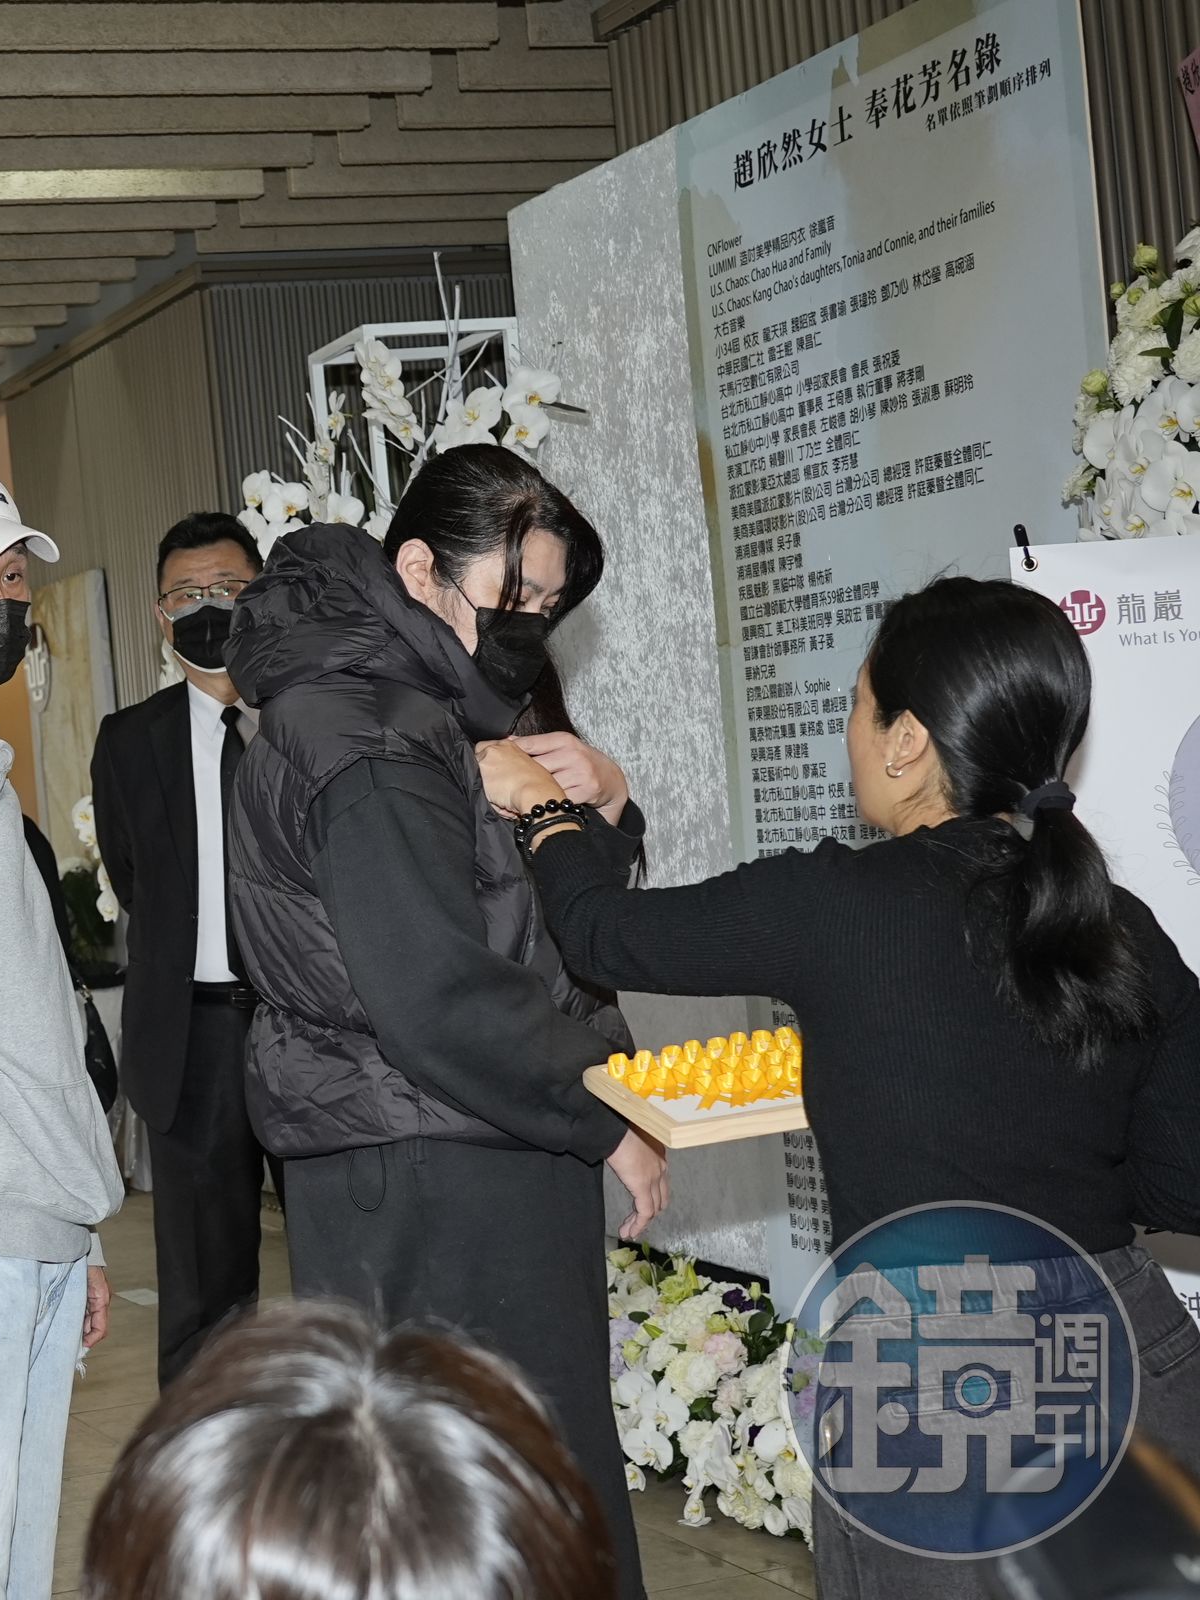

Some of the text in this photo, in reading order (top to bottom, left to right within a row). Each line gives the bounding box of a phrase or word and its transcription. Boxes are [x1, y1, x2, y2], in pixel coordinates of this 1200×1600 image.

[733, 31, 1002, 192] 趙欣然女士 奉花芳名錄
[924, 57, 1052, 133] 名單依照筆劃順序排列
[706, 235, 742, 258] CNFlower
[711, 200, 996, 319] U.S. Chaos: Kang Chao's daughters,Tonia and Connie, and their families
[708, 255, 737, 278] LUMIMI
[710, 240, 832, 298] U.S. Chaos: Chao Hua and Family
[715, 337, 741, 360] 小34屆
[743, 331, 760, 349] 校友
[762, 320, 788, 343] 龍天琪
[849, 289, 877, 313] 張瑋玲
[880, 278, 909, 303] 鄧乃心
[944, 252, 975, 279] 高琬涵
[713, 315, 746, 339] 大右音樂
[716, 351, 765, 379] 中華民國仁社
[796, 331, 823, 353] 陳昌仁
[719, 359, 800, 400] 天馬行空數位有限公司
[720, 385, 793, 420] 台北市私立靜心高中
[796, 367, 847, 397] 小學部家長會
[850, 359, 869, 379] 會長
[722, 406, 795, 440] 台北市私立靜心高中
[797, 395, 824, 418] 董事長
[856, 374, 893, 400] 執行董事
[896, 364, 925, 388] 蔣孝剛
[724, 430, 780, 460] 私立靜心中小學
[783, 419, 817, 443] 家長會長
[880, 393, 908, 416] 陳妙玲
[911, 383, 941, 407] 張淑惠
[943, 373, 974, 398] 蘇明玲
[726, 430, 861, 481] 表演工作坊 賴聲川 丁乃竺 全體同仁
[728, 452, 859, 500] 派拉蒙影業亞太總部 楊宣友 李芳慧
[835, 468, 880, 495] 台灣分公司
[882, 460, 911, 483] 總經理
[828, 493, 873, 518] 台灣分公司
[875, 485, 904, 507] 總經理
[776, 532, 802, 552] 吳子康
[738, 581, 770, 601] 疾風魅影
[772, 574, 805, 593] 黑貓中隊
[741, 622, 773, 642] 復興商工
[776, 611, 833, 636] 美工科美班同學
[865, 600, 892, 621] 曹書
[1116, 589, 1184, 625] 龍巖
[1119, 628, 1200, 647] What Is Yo
[744, 664, 777, 681] 華納兄弟
[804, 677, 831, 696] Sophie
[822, 695, 847, 714] 總經理
[749, 717, 845, 742] 萬泰物流集團 業務處 協理
[751, 762, 827, 783] 滿足藝術中心 廖滿足
[753, 784, 825, 804] 臺北市私立靜心高中
[827, 782, 845, 799] 校長
[755, 803, 859, 824] 臺北市私立靜心高中 全體主
[756, 824, 885, 844] 臺北市私立靜心高中 校友會 理事長
